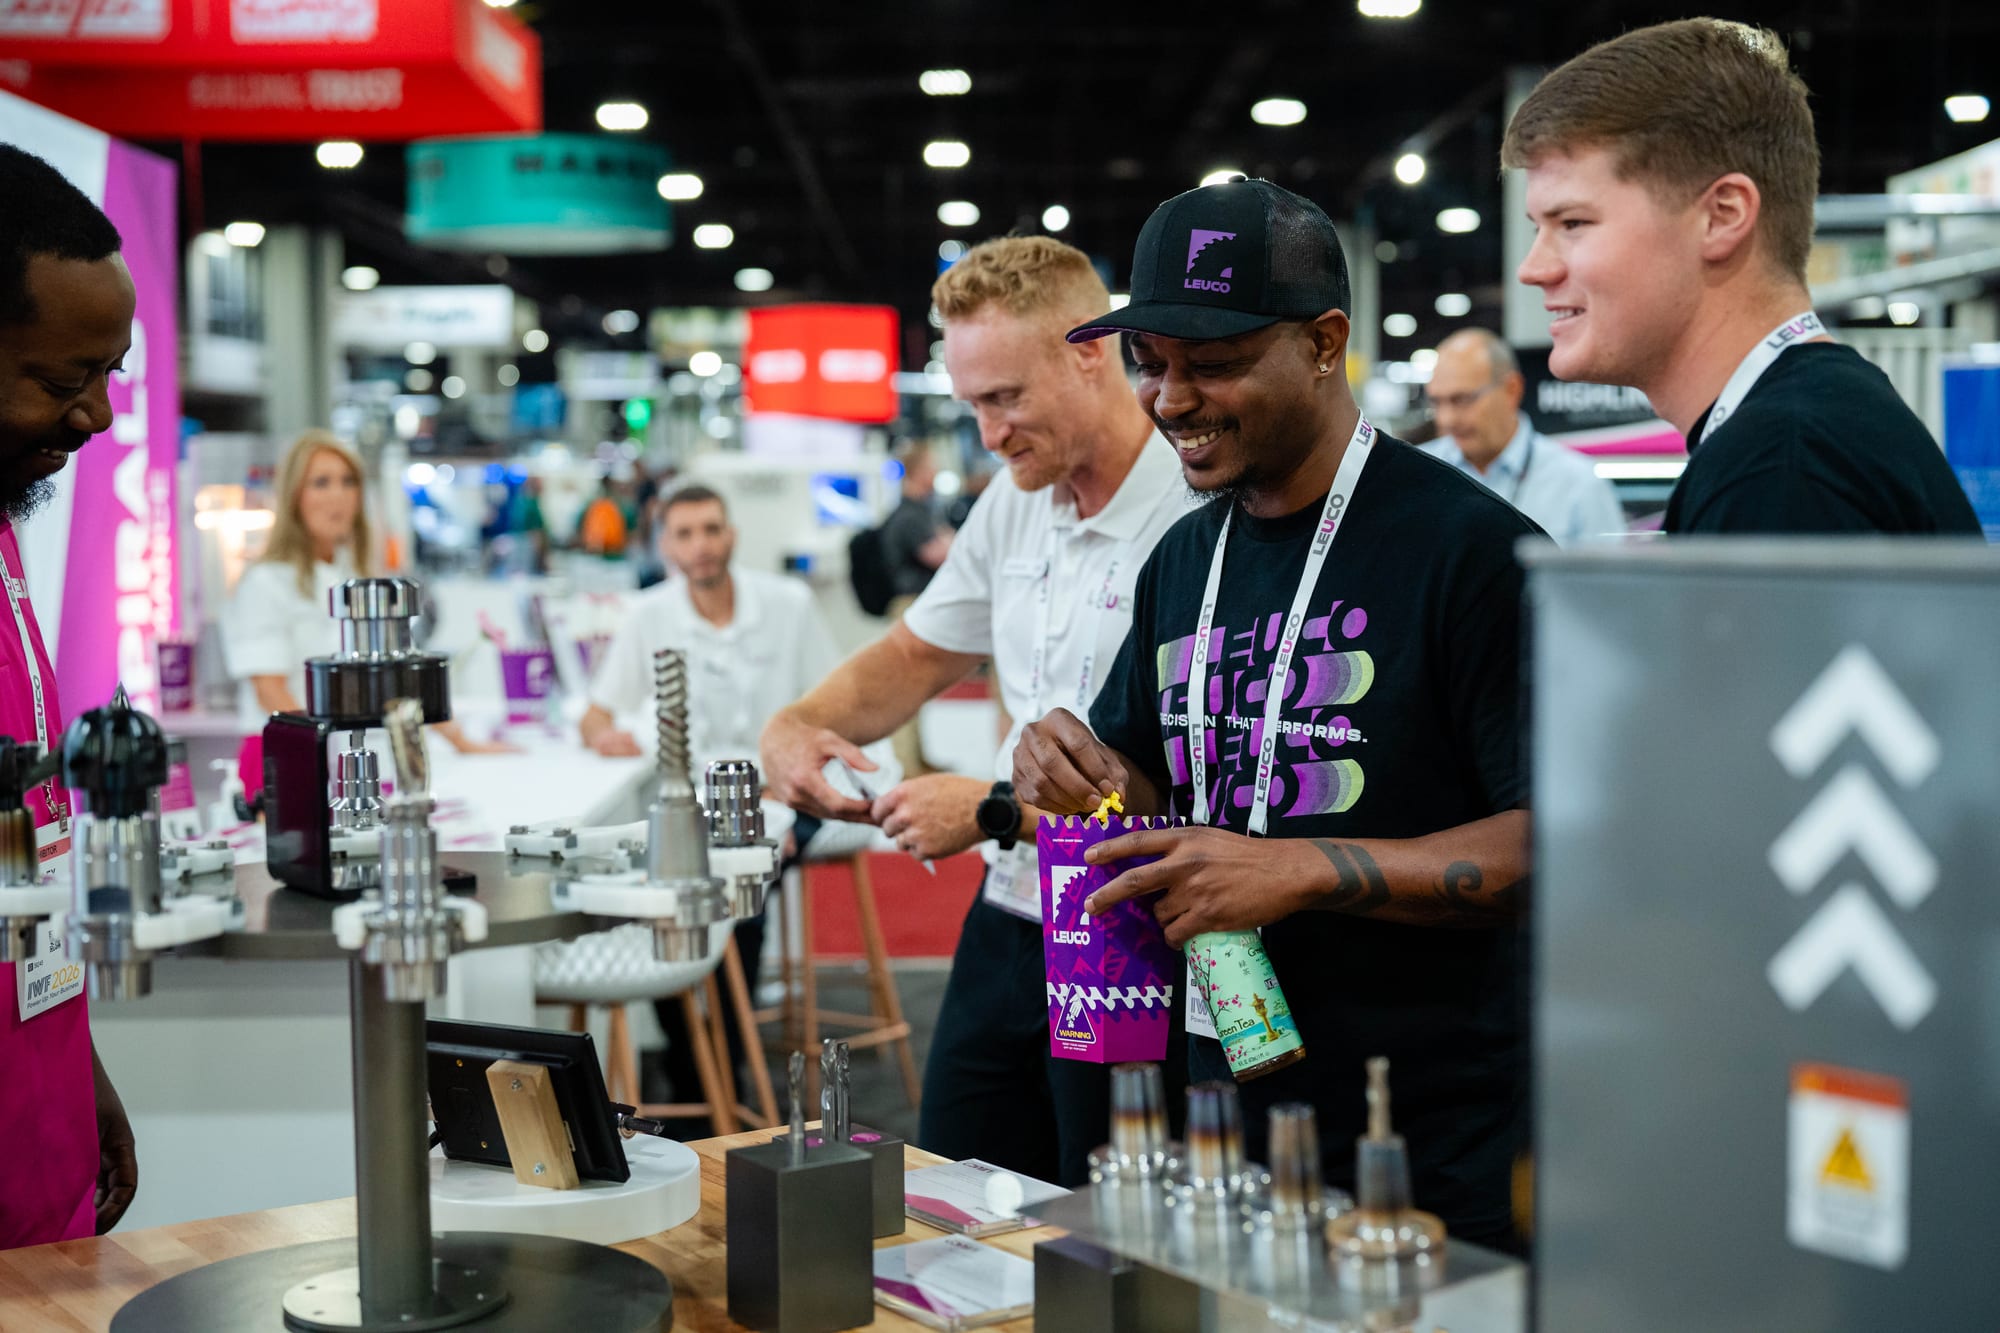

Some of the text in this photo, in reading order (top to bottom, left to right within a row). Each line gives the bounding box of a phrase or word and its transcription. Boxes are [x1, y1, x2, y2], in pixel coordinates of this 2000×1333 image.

[1184, 278, 1231, 294] LEUCO
[1355, 417, 1373, 446] LEU
[1313, 494, 1344, 556] LEUCO
[1195, 603, 1213, 664] LEUCO
[1276, 613, 1301, 678] LEUCO
[33, 675, 45, 742] LEUCO
[1225, 715, 1258, 730] THAT
[1275, 720, 1368, 743] ERFORMS.
[1191, 723, 1203, 786] LEUCO
[1257, 737, 1272, 804] LEUCO
[1052, 930, 1091, 946] LEUCO
[28, 962, 80, 1001] IWF 2026
[1191, 998, 1208, 1016] IW
[1234, 1018, 1255, 1030] Tea
[1059, 1029, 1091, 1040] WARNING
